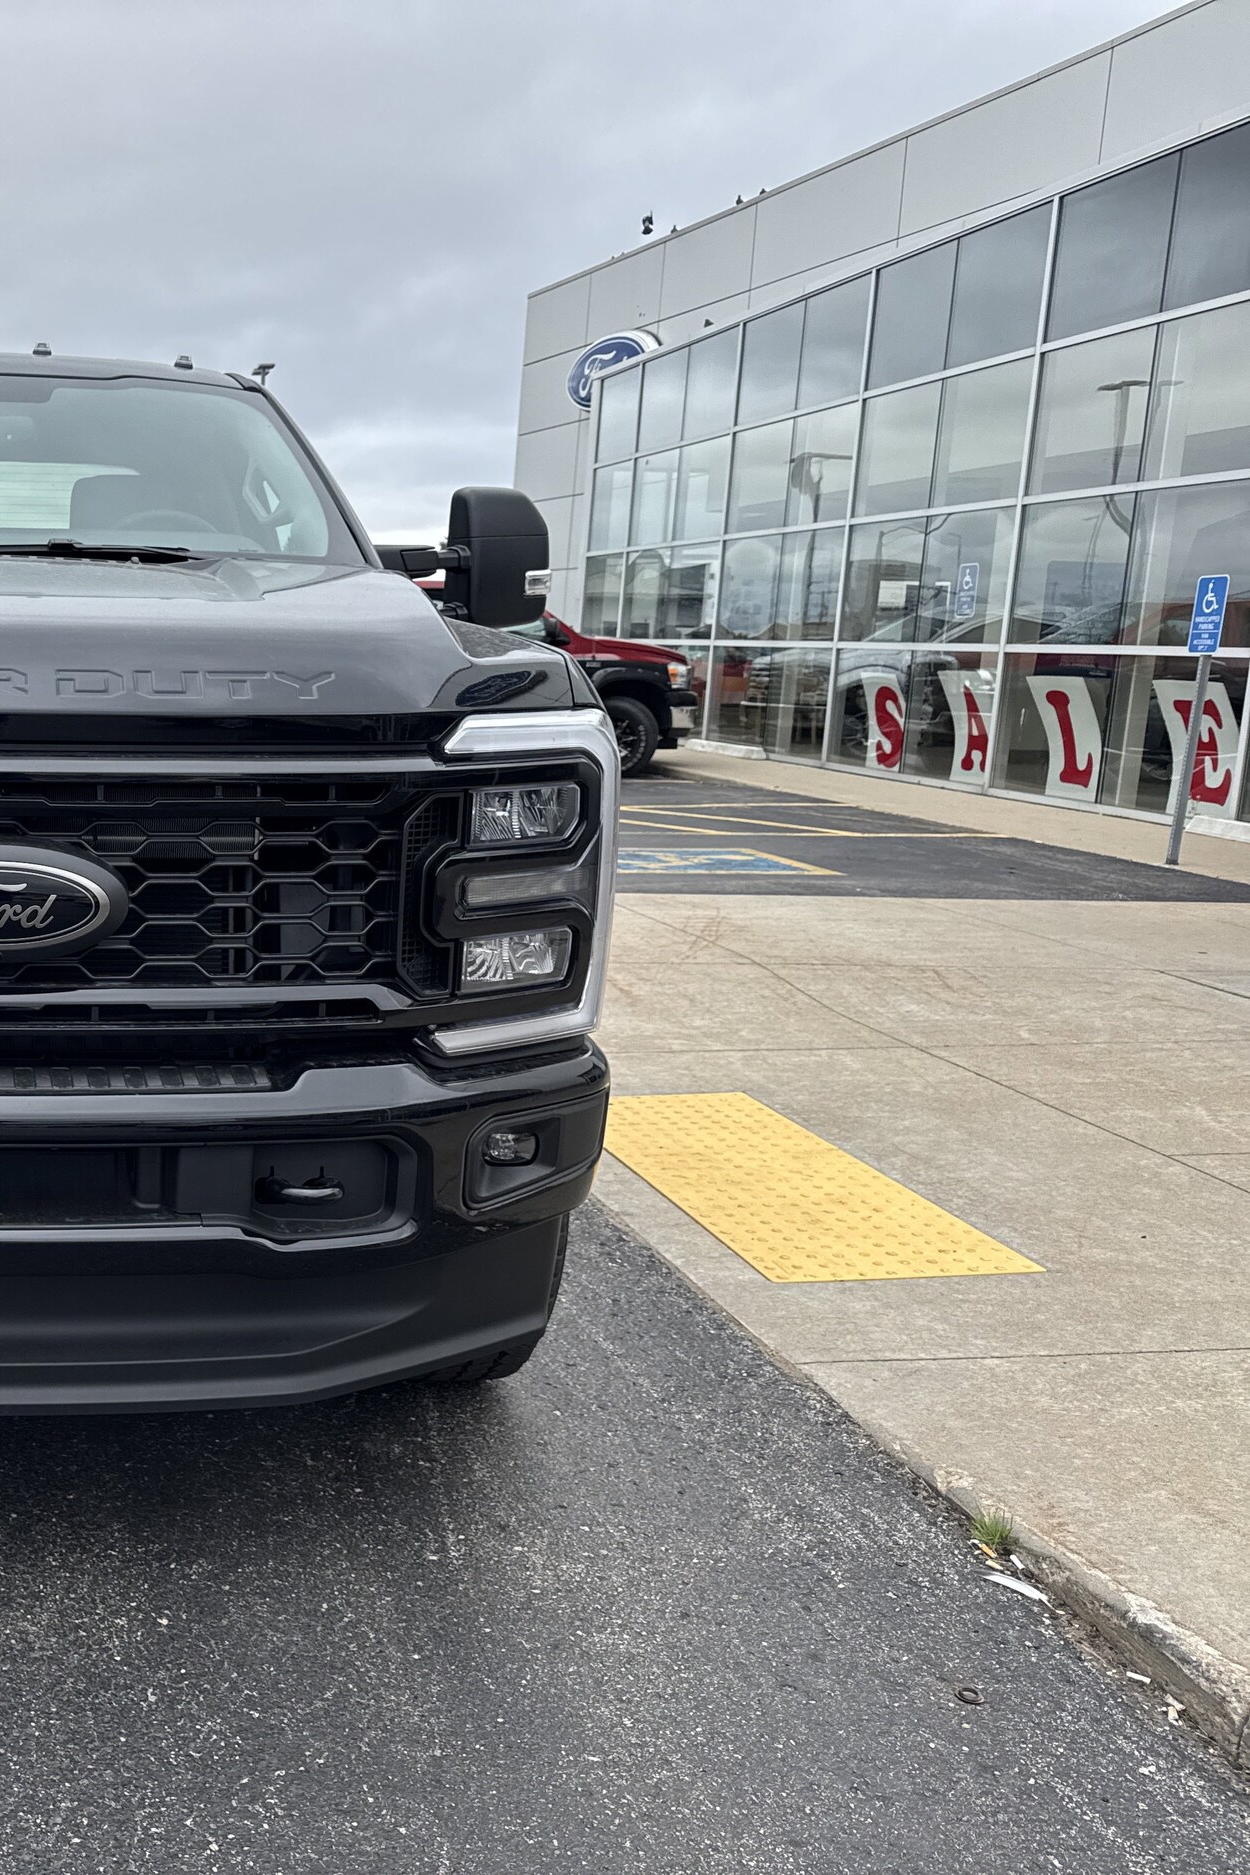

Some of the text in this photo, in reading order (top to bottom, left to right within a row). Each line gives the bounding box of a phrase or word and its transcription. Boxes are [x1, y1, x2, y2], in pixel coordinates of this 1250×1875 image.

[1194, 615, 1220, 623] HANDICAPPED
[55, 668, 335, 700] DUTY
[874, 685, 1232, 807] SALE
